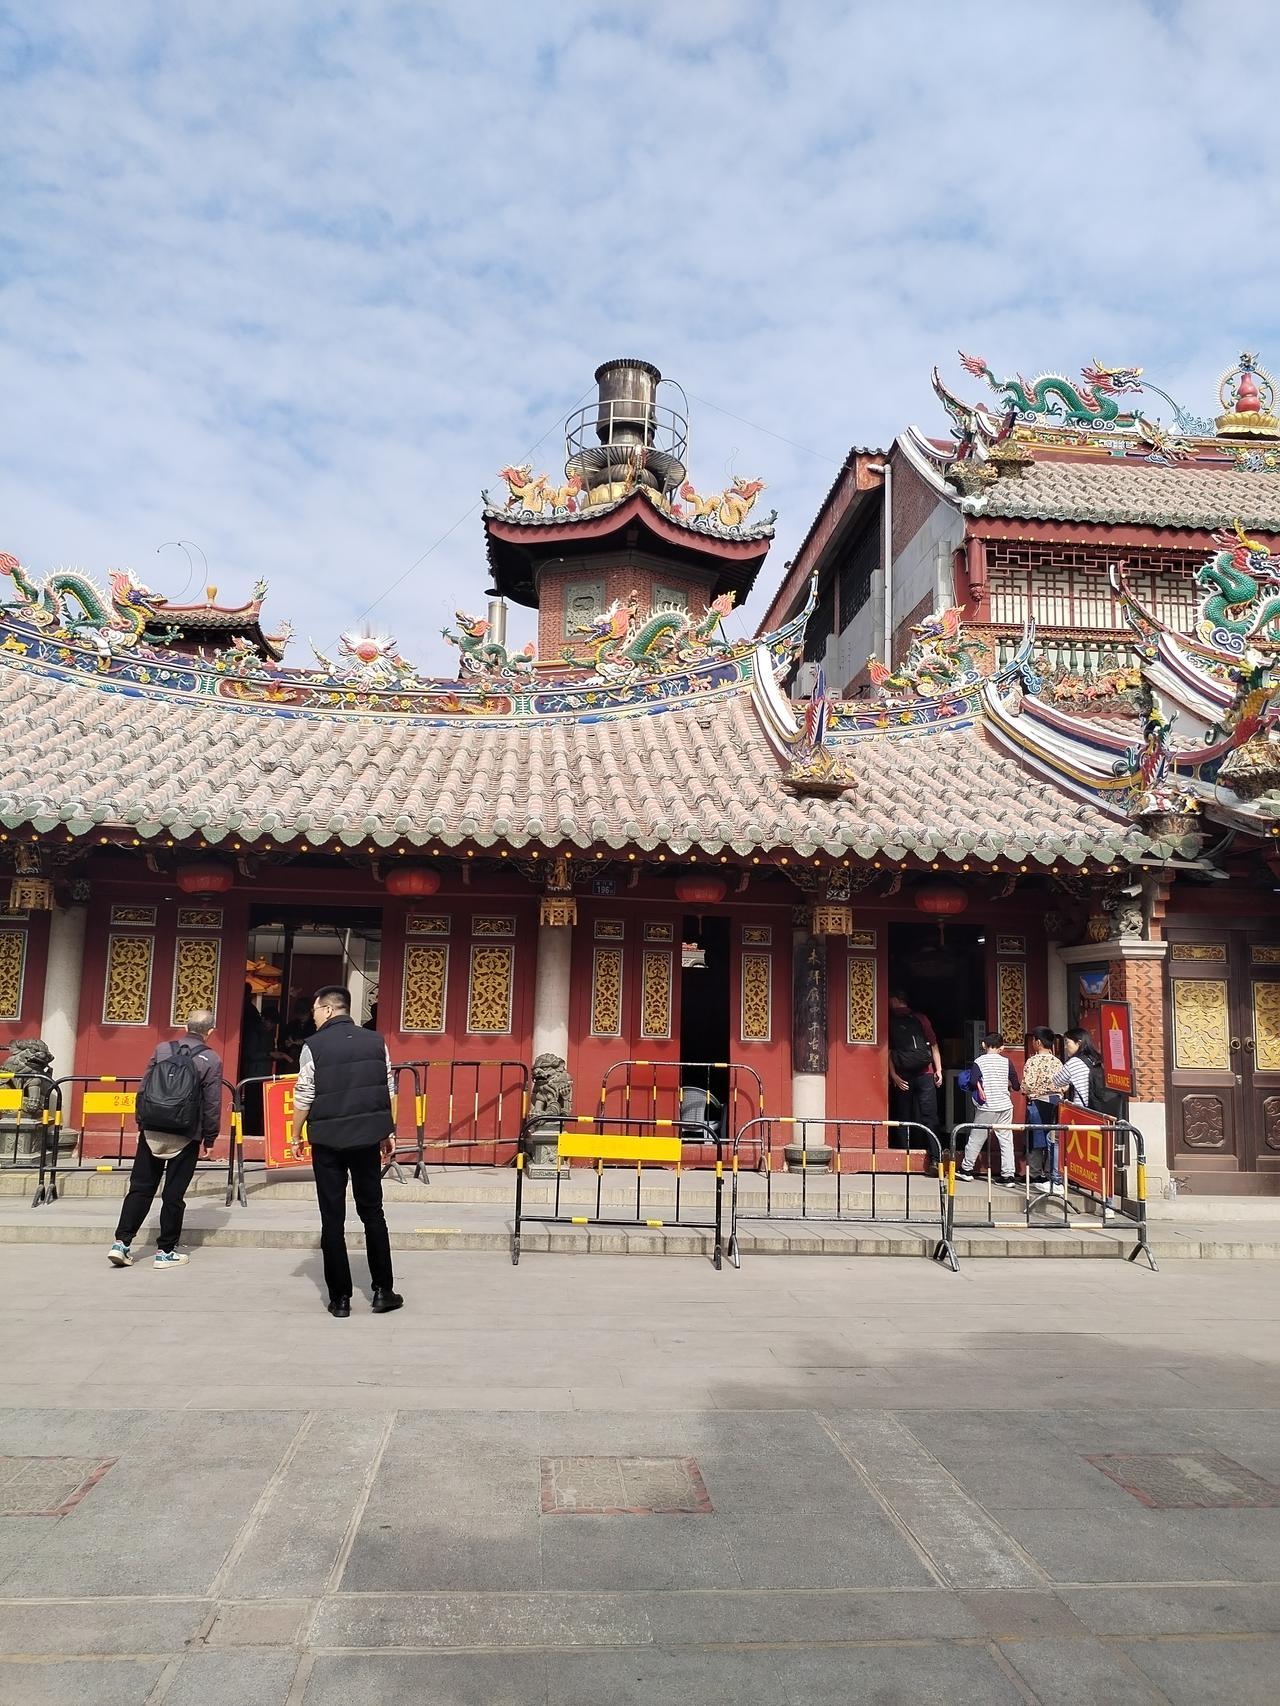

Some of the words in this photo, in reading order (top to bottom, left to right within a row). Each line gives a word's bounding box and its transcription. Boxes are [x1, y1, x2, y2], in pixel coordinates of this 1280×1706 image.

[1107, 1073, 1130, 1088] ENTRANCE
[1066, 1119, 1103, 1167] 入口
[1070, 1162, 1098, 1183] ENTRANCE
